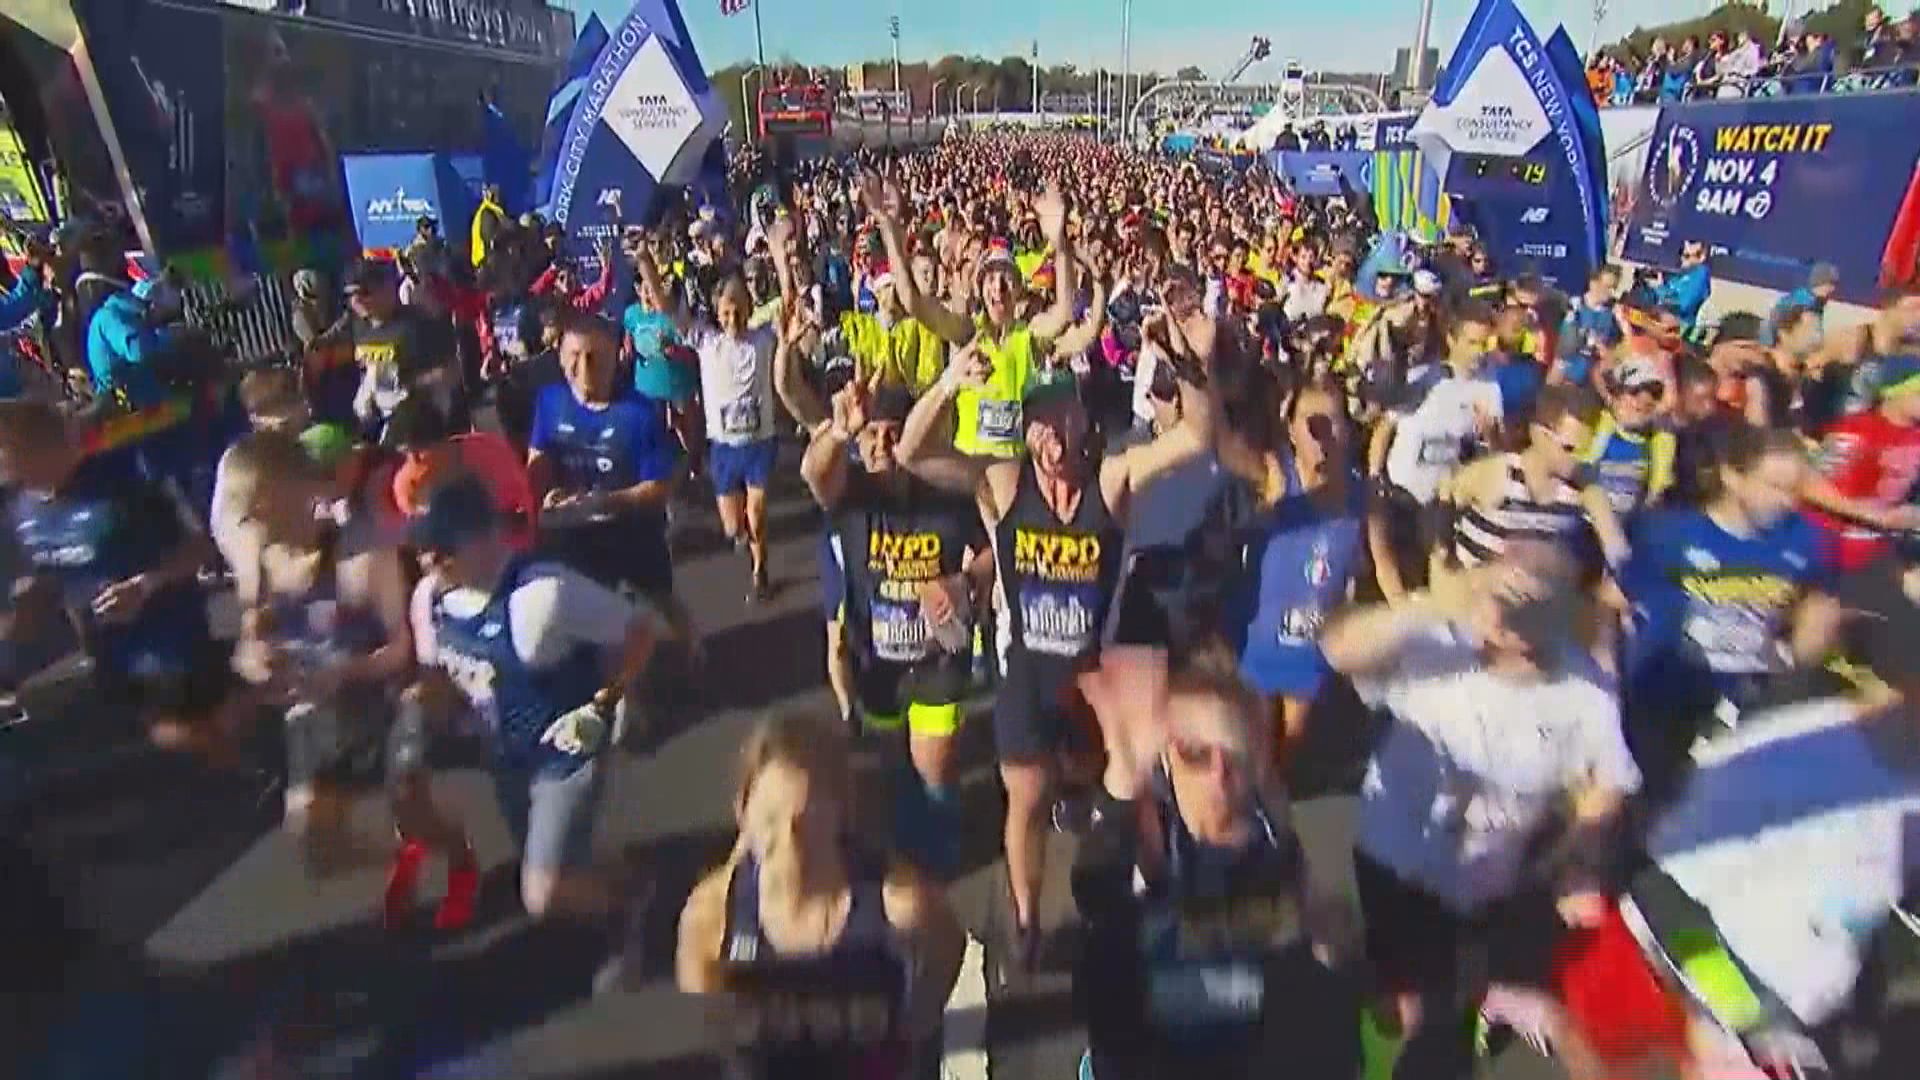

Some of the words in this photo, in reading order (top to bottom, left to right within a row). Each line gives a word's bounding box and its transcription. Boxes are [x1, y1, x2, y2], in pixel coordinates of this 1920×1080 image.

[1509, 24, 1539, 70] TCS
[1532, 70, 1562, 118] NEW
[637, 95, 668, 105] TATA
[1481, 106, 1513, 117] TATA
[555, 180, 575, 230] ORK
[566, 126, 589, 175] CITY
[583, 13, 649, 127] MARATHON
[1715, 124, 1800, 152] WATCH
[1801, 123, 1832, 152] IT
[1703, 157, 1754, 184] NOV.
[1760, 159, 1778, 186] 4
[1696, 187, 1742, 216] 9AM
[1015, 529, 1101, 563] NYPD
